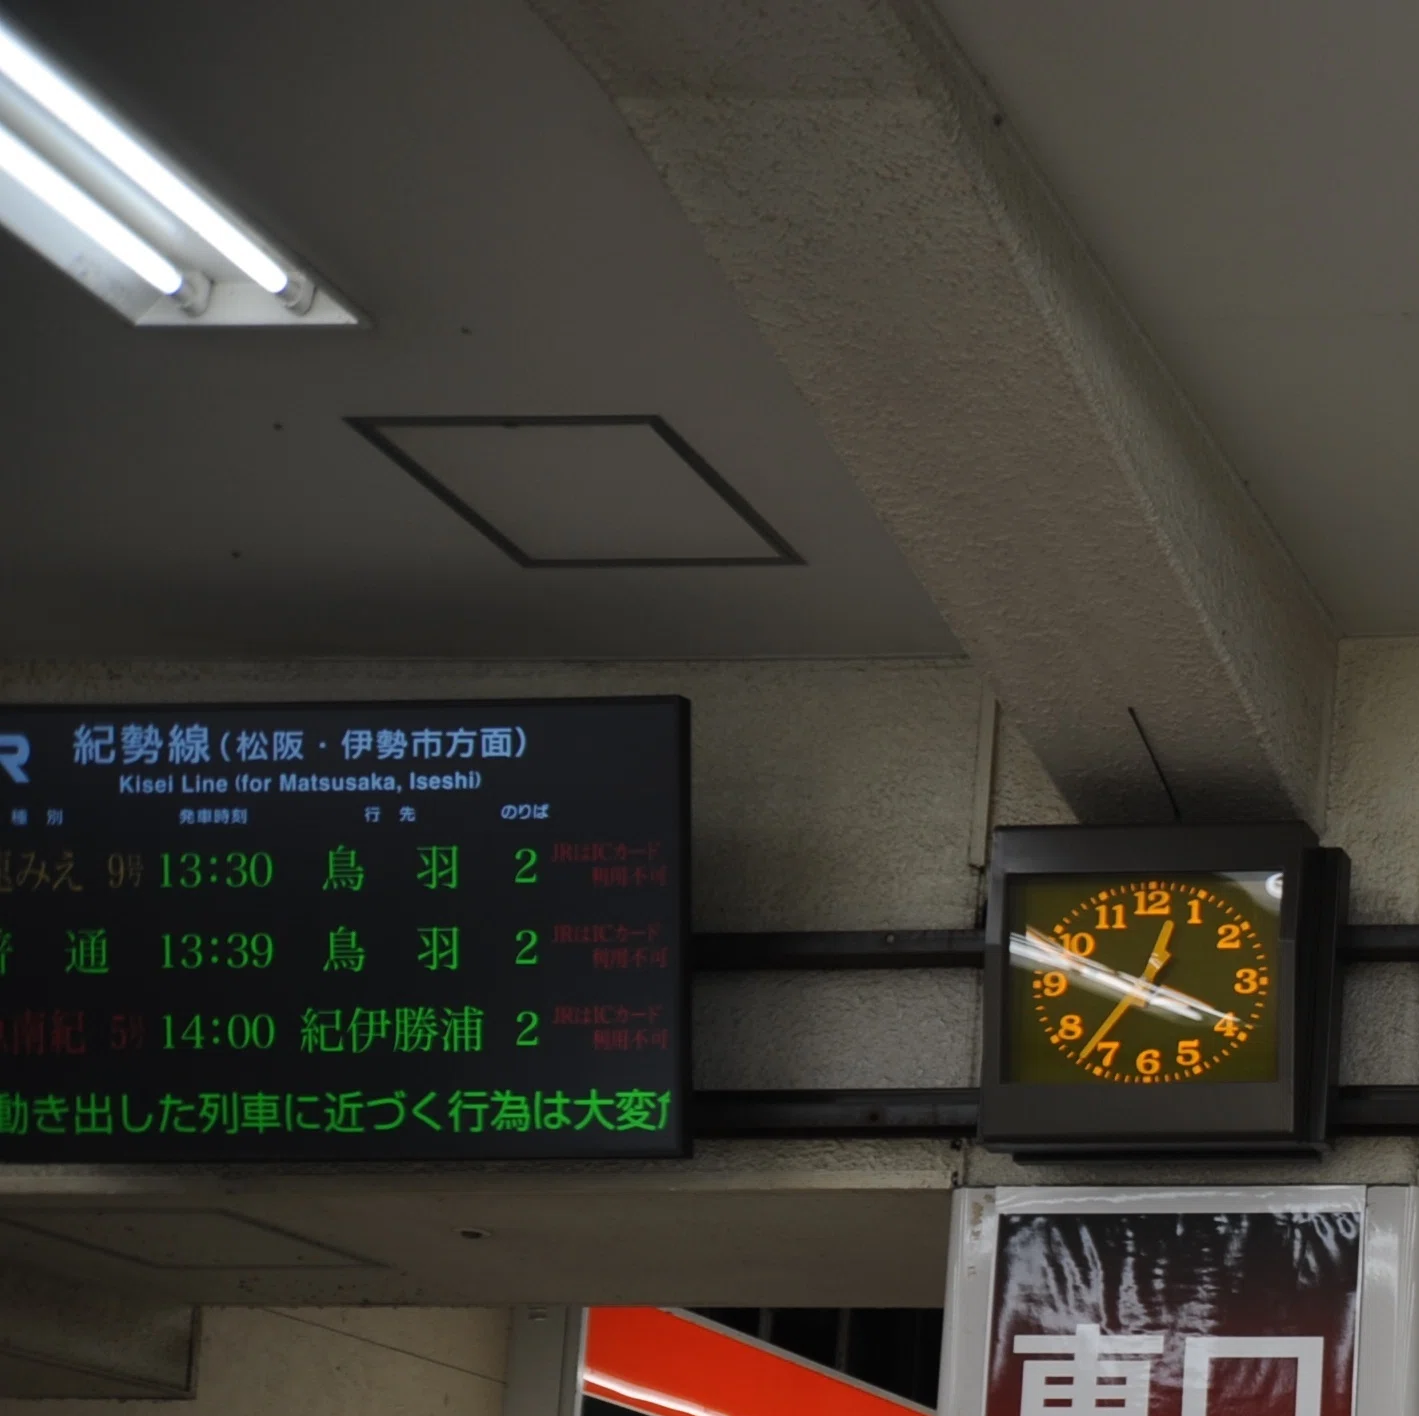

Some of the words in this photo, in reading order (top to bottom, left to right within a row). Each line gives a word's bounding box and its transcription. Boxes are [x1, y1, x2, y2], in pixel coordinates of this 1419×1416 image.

[120, 775, 174, 794] Kisei
[182, 775, 228, 793] Line
[235, 774, 272, 792] (for
[280, 772, 402, 793] Matsusaka,
[410, 771, 481, 790] Iseshi)
[179, 808, 248, 824] 発車時刻
[501, 804, 549, 819] のりば
[162, 852, 273, 887] 13:30
[515, 849, 537, 883] 2
[1133, 890, 1171, 916] 12
[1187, 900, 1203, 925] 1
[1095, 904, 1128, 929] 11
[163, 933, 274, 968] 13:39
[516, 930, 538, 964] 2
[1060, 931, 1096, 958] 10
[1216, 923, 1243, 949] 2
[1043, 971, 1067, 997] 9
[1234, 968, 1258, 994] 3
[164, 1014, 275, 1048] 14:00
[301, 1006, 484, 1053] 紀伊勝浦
[516, 1011, 538, 1046] 2
[1058, 1015, 1083, 1040] 8
[1213, 1012, 1238, 1037] 4
[1096, 1041, 1120, 1067] 7
[1135, 1050, 1161, 1076] 6
[1176, 1040, 1201, 1066] 5
